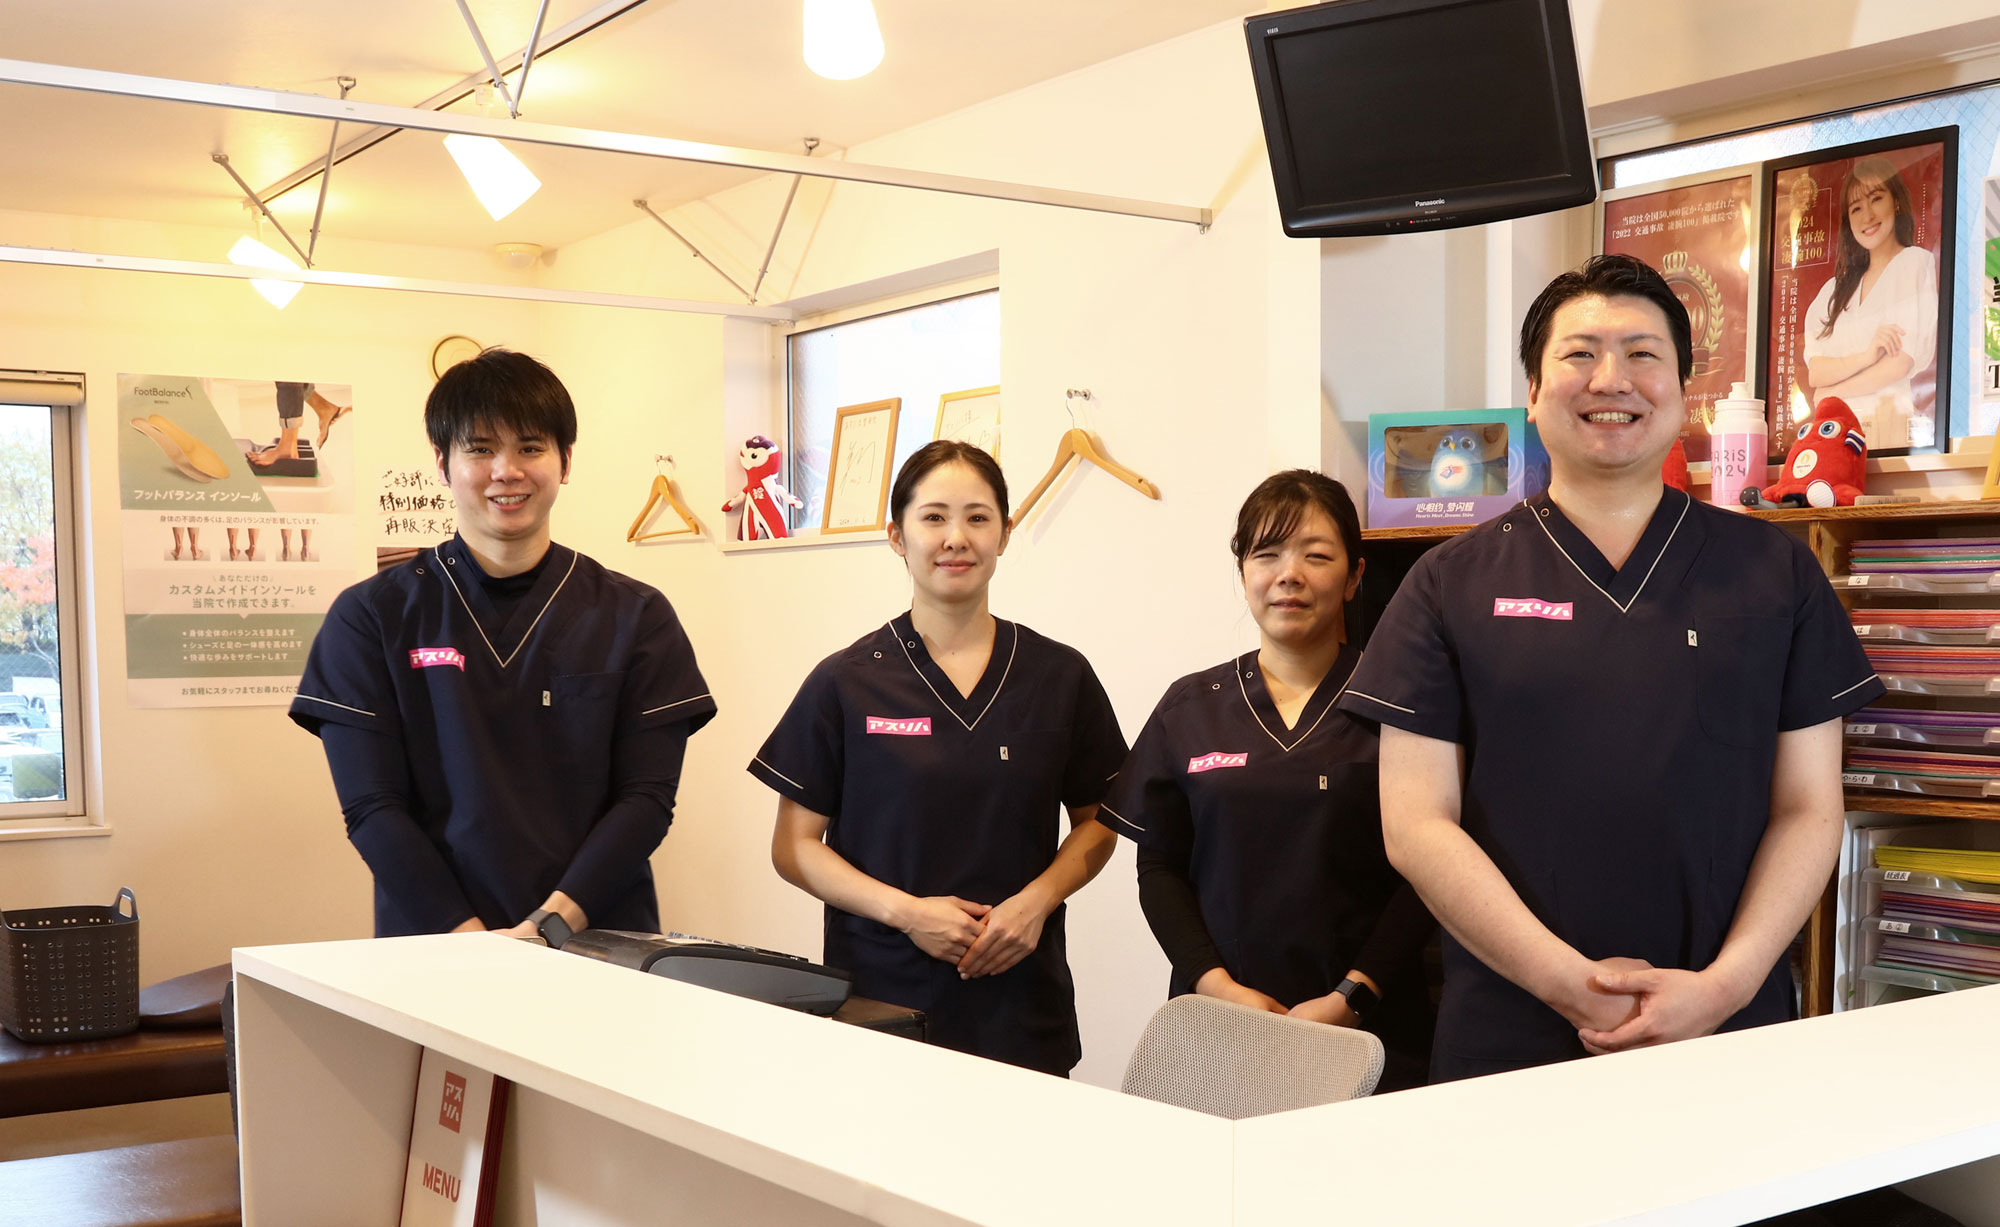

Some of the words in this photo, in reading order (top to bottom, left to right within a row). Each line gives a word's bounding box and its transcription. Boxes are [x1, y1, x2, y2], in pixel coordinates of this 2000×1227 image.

[1415, 198, 1446, 207] Panasonic
[134, 386, 186, 398] FootBalance
[1711, 465, 1746, 479] 024
[134, 489, 205, 501] フットバランス
[209, 490, 262, 502] インソール
[169, 585, 317, 596] カスタムメイドインソールを
[1498, 602, 1570, 617] アスリハ
[869, 720, 929, 732] アスリハ
[1191, 755, 1244, 770] アスリハ
[445, 1082, 463, 1102] アス
[443, 1101, 460, 1122] リハ
[422, 1162, 461, 1203] MENU
